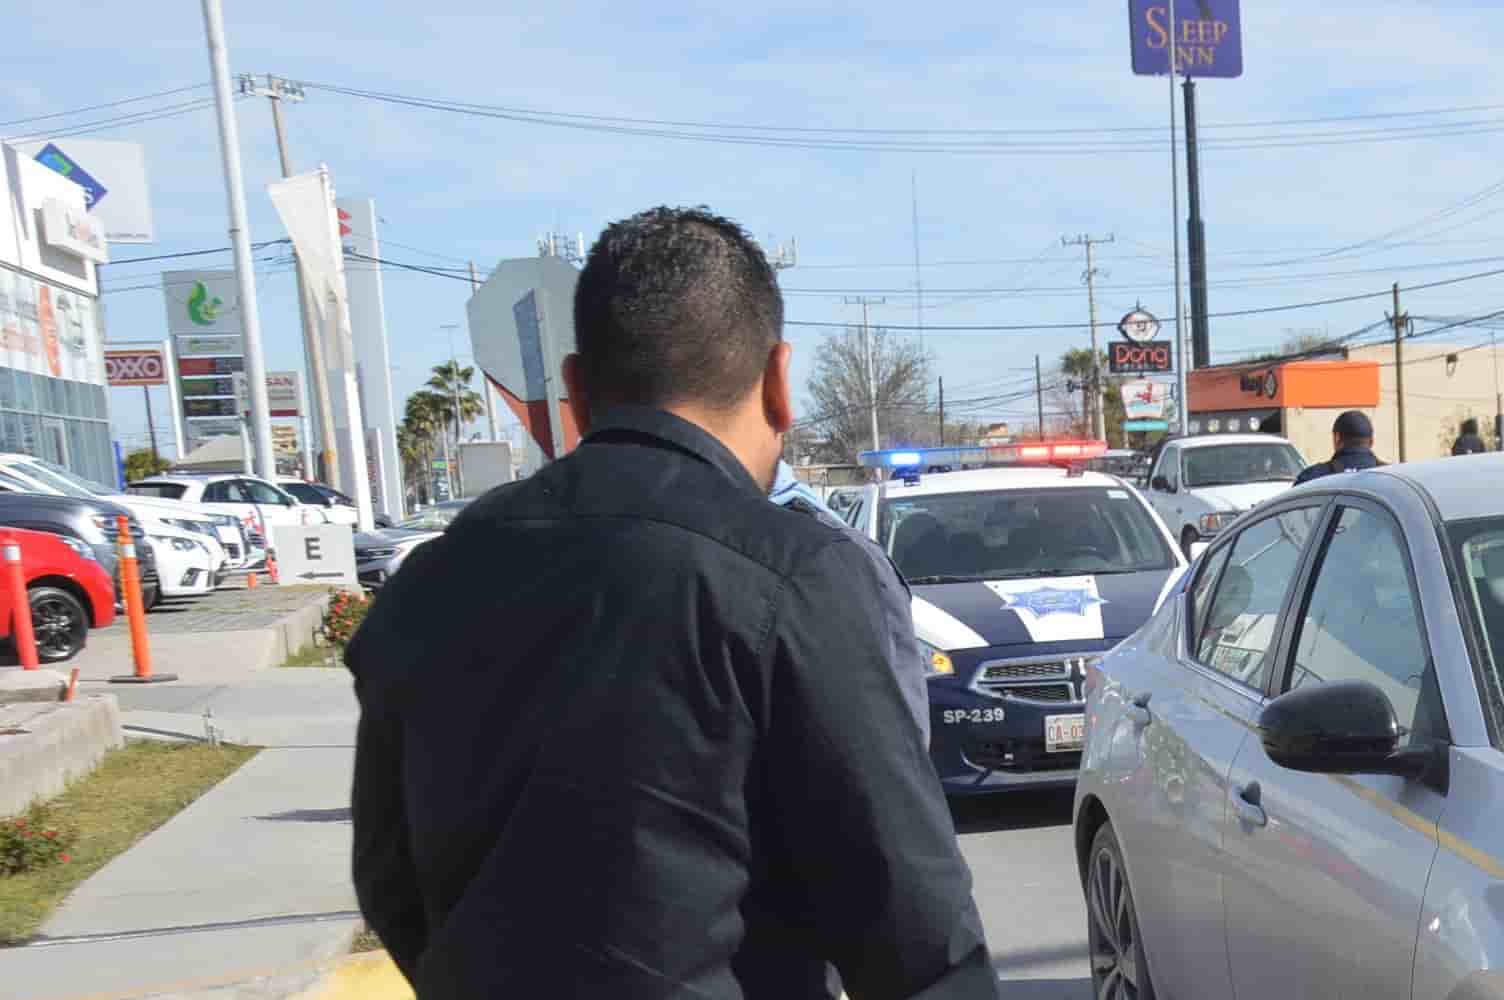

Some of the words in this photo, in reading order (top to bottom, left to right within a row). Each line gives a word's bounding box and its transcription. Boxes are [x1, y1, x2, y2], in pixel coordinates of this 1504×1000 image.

[1145, 7, 1228, 48] SEEP
[103, 357, 161, 379] OXXO
[304, 537, 322, 560] E
[943, 707, 1005, 724] SP-239
